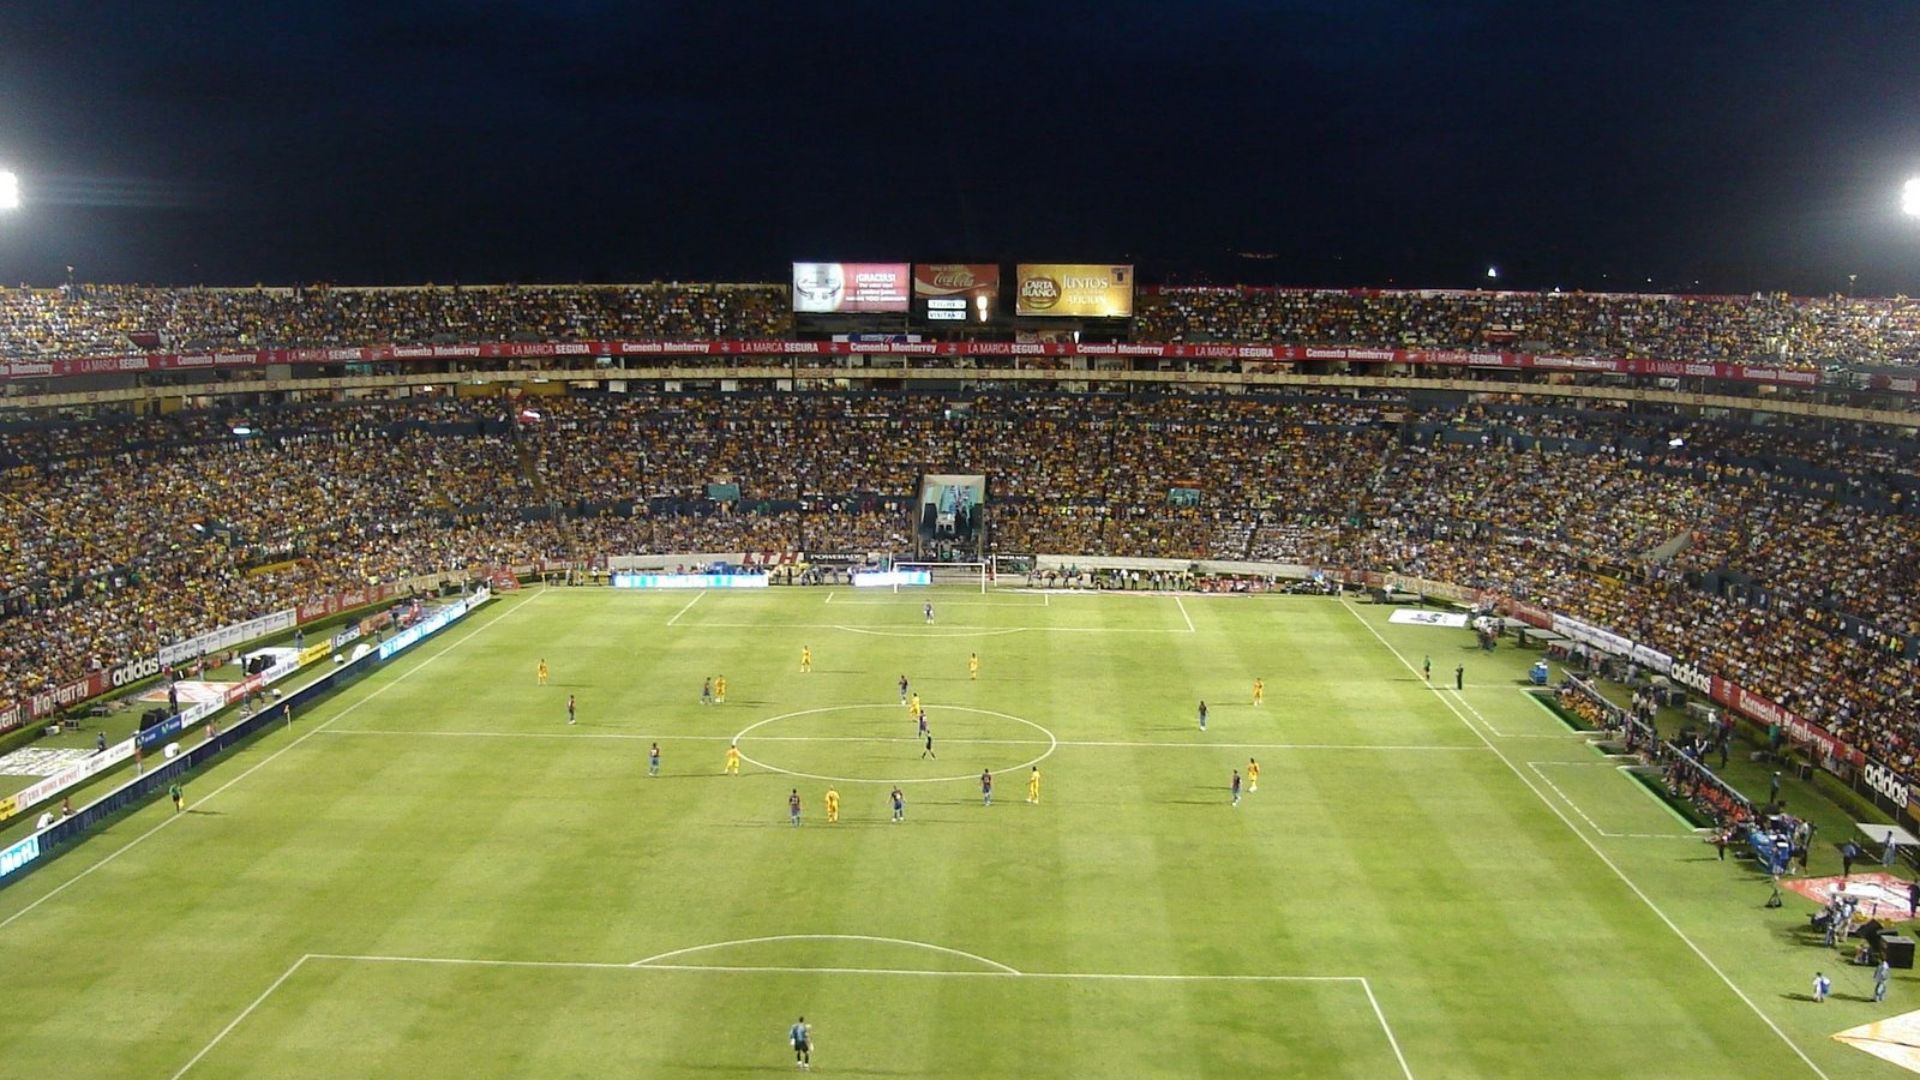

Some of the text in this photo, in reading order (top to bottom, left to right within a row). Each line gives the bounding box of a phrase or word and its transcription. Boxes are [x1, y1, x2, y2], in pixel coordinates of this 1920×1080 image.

[1025, 281, 1053, 289] CARTA
[1063, 275, 1108, 289] JUNTOS
[1022, 288, 1057, 297] BLANCA
[434, 346, 480, 357] Monterrey
[511, 344, 590, 355] LA MARCA SEGURA
[622, 342, 710, 353] Cemento Monterrey
[741, 343, 819, 352] LA MARCA SEGURA
[850, 343, 937, 354] Cemento Monterrey
[968, 344, 1045, 354] LA MARCA SEGURA
[1077, 344, 1164, 356] Cemento Monterrey
[1195, 347, 1274, 357] LA MARCA SEGURA
[1306, 348, 1394, 361] Cemento Monterrey
[112, 657, 159, 687] adidas
[1671, 663, 1711, 694] adidas
[1864, 762, 1910, 809] adidas
